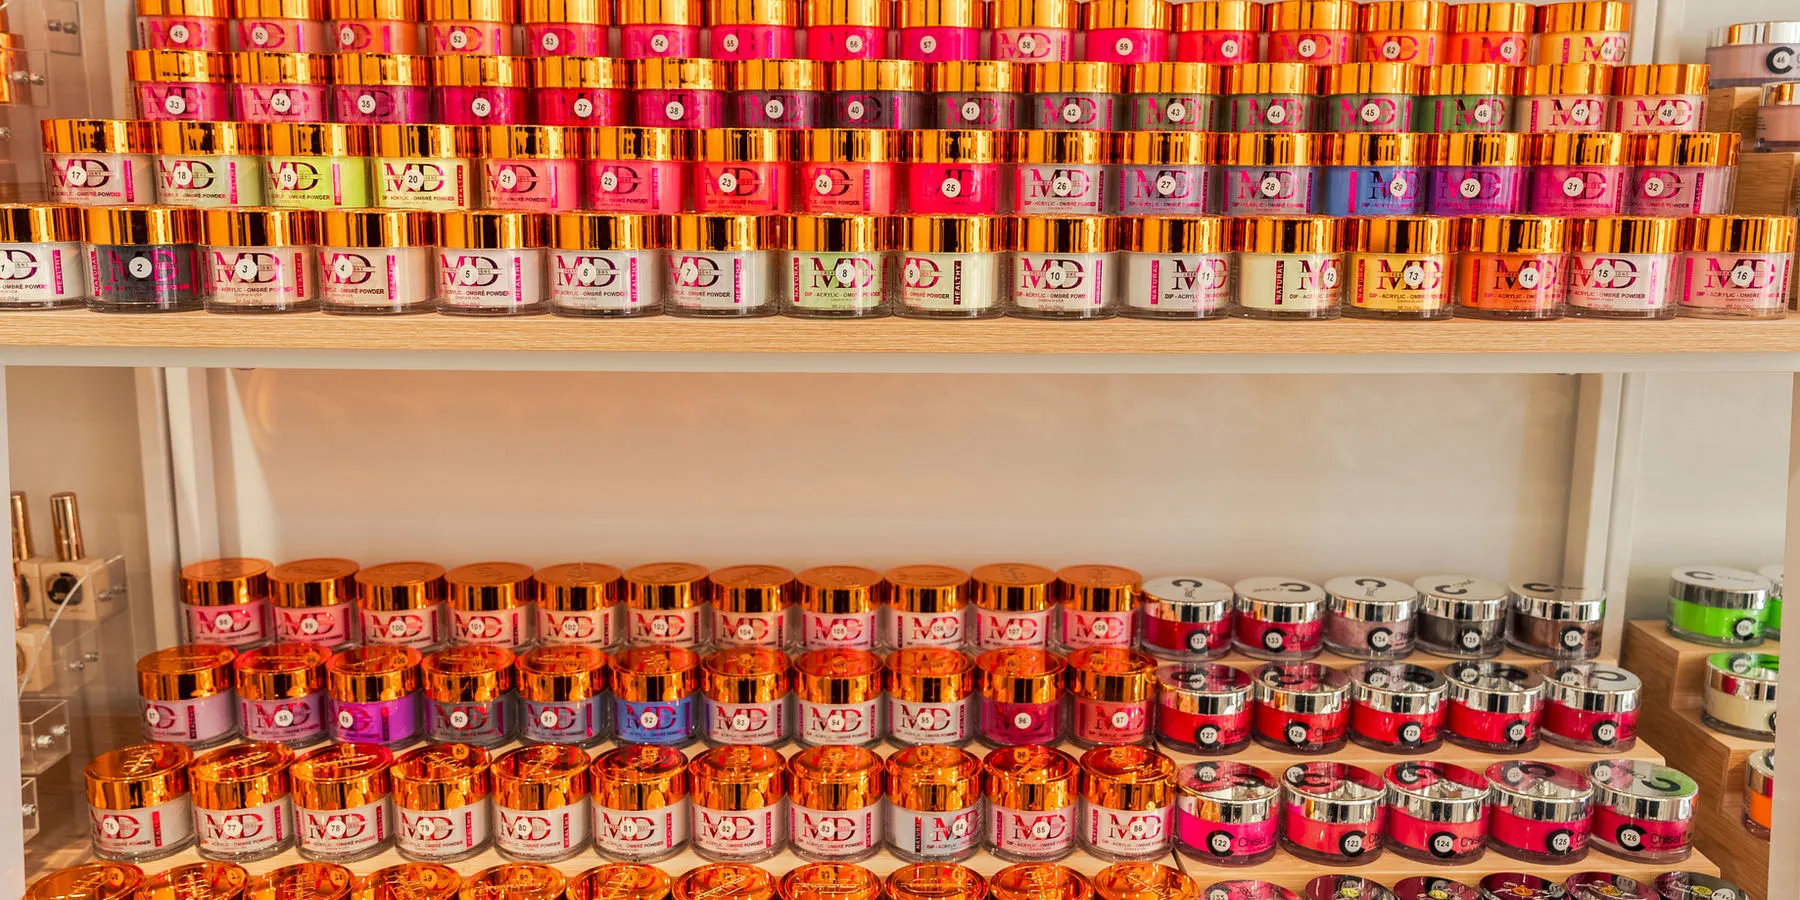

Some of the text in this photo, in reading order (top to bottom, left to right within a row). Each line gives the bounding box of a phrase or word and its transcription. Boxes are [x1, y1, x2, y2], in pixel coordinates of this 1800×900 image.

[173, 30, 184, 39] 49
[255, 32, 263, 40] 50
[453, 35, 462, 44] 52
[545, 37, 554, 46] 53
[654, 38, 664, 47] 54
[726, 39, 735, 48] 55
[849, 40, 859, 49] 56
[923, 40, 932, 49] 57
[1022, 41, 1031, 49] 58
[1119, 43, 1129, 51] 59
[1302, 44, 1311, 53] 61
[1386, 46, 1396, 55] 62
[169, 100, 180, 110] 33
[275, 98, 285, 107] 34
[361, 99, 371, 109] 35
[475, 102, 486, 112] 36
[577, 103, 588, 112] 37
[669, 106, 679, 115] 38
[769, 104, 779, 114] 39
[850, 106, 860, 115] 40
[965, 107, 975, 115] 41
[1575, 108, 1585, 116] 47
[1066, 108, 1076, 117] 42
[1170, 108, 1180, 117] 43
[1270, 110, 1280, 118] 44
[1364, 109, 1375, 117] 45
[1478, 109, 1488, 118] 46
[1662, 109, 1673, 118] 48
[71, 171, 81, 180] 17
[177, 171, 187, 180] 18
[283, 173, 292, 183] 19
[408, 174, 418, 184] 20
[502, 174, 511, 184] 21
[603, 176, 613, 186] 22
[721, 177, 732, 188] 23
[818, 179, 828, 189] 24
[1160, 180, 1171, 189] 27
[945, 183, 956, 193] 25
[1056, 181, 1067, 191] 26
[1264, 181, 1276, 192] 28
[1393, 181, 1404, 192] 29
[1464, 182, 1476, 193] 30
[1567, 182, 1578, 192] 31
[1648, 182, 1659, 192] 32
[136, 263, 143, 273] 2
[241, 264, 248, 274] 3
[339, 264, 345, 272] 4
[583, 268, 589, 277] 6
[685, 267, 692, 277] 7
[465, 269, 471, 279] 5
[842, 268, 848, 278] 8
[1050, 271, 1061, 281] 10
[1202, 271, 1210, 281] 11
[1327, 272, 1334, 281] 12
[1408, 271, 1419, 281] 13
[1523, 273, 1534, 282] 14
[1598, 268, 1609, 278] 15
[1737, 270, 1748, 281] 16
[954, 264, 962, 304] HEALTHY
[1192, 637, 1204, 645] 132
[454, 715, 463, 723] 90
[544, 715, 552, 723] 91
[644, 716, 654, 724] 92
[736, 718, 745, 727] 93
[921, 716, 930, 724] 95
[1018, 716, 1027, 725] 96
[1115, 716, 1124, 724] 97
[106, 823, 114, 831] 76
[226, 824, 237, 832] 77
[330, 824, 341, 832] 78
[420, 824, 430, 832] 79
[518, 823, 527, 832] 80
[623, 824, 632, 833] 81
[721, 824, 731, 833] 82
[820, 824, 831, 833] 83
[1133, 824, 1143, 833] 86
[1623, 833, 1637, 842] 126
[1650, 833, 1681, 844] Chisel
[1214, 838, 1228, 848] 122
[1436, 839, 1450, 848] 124
